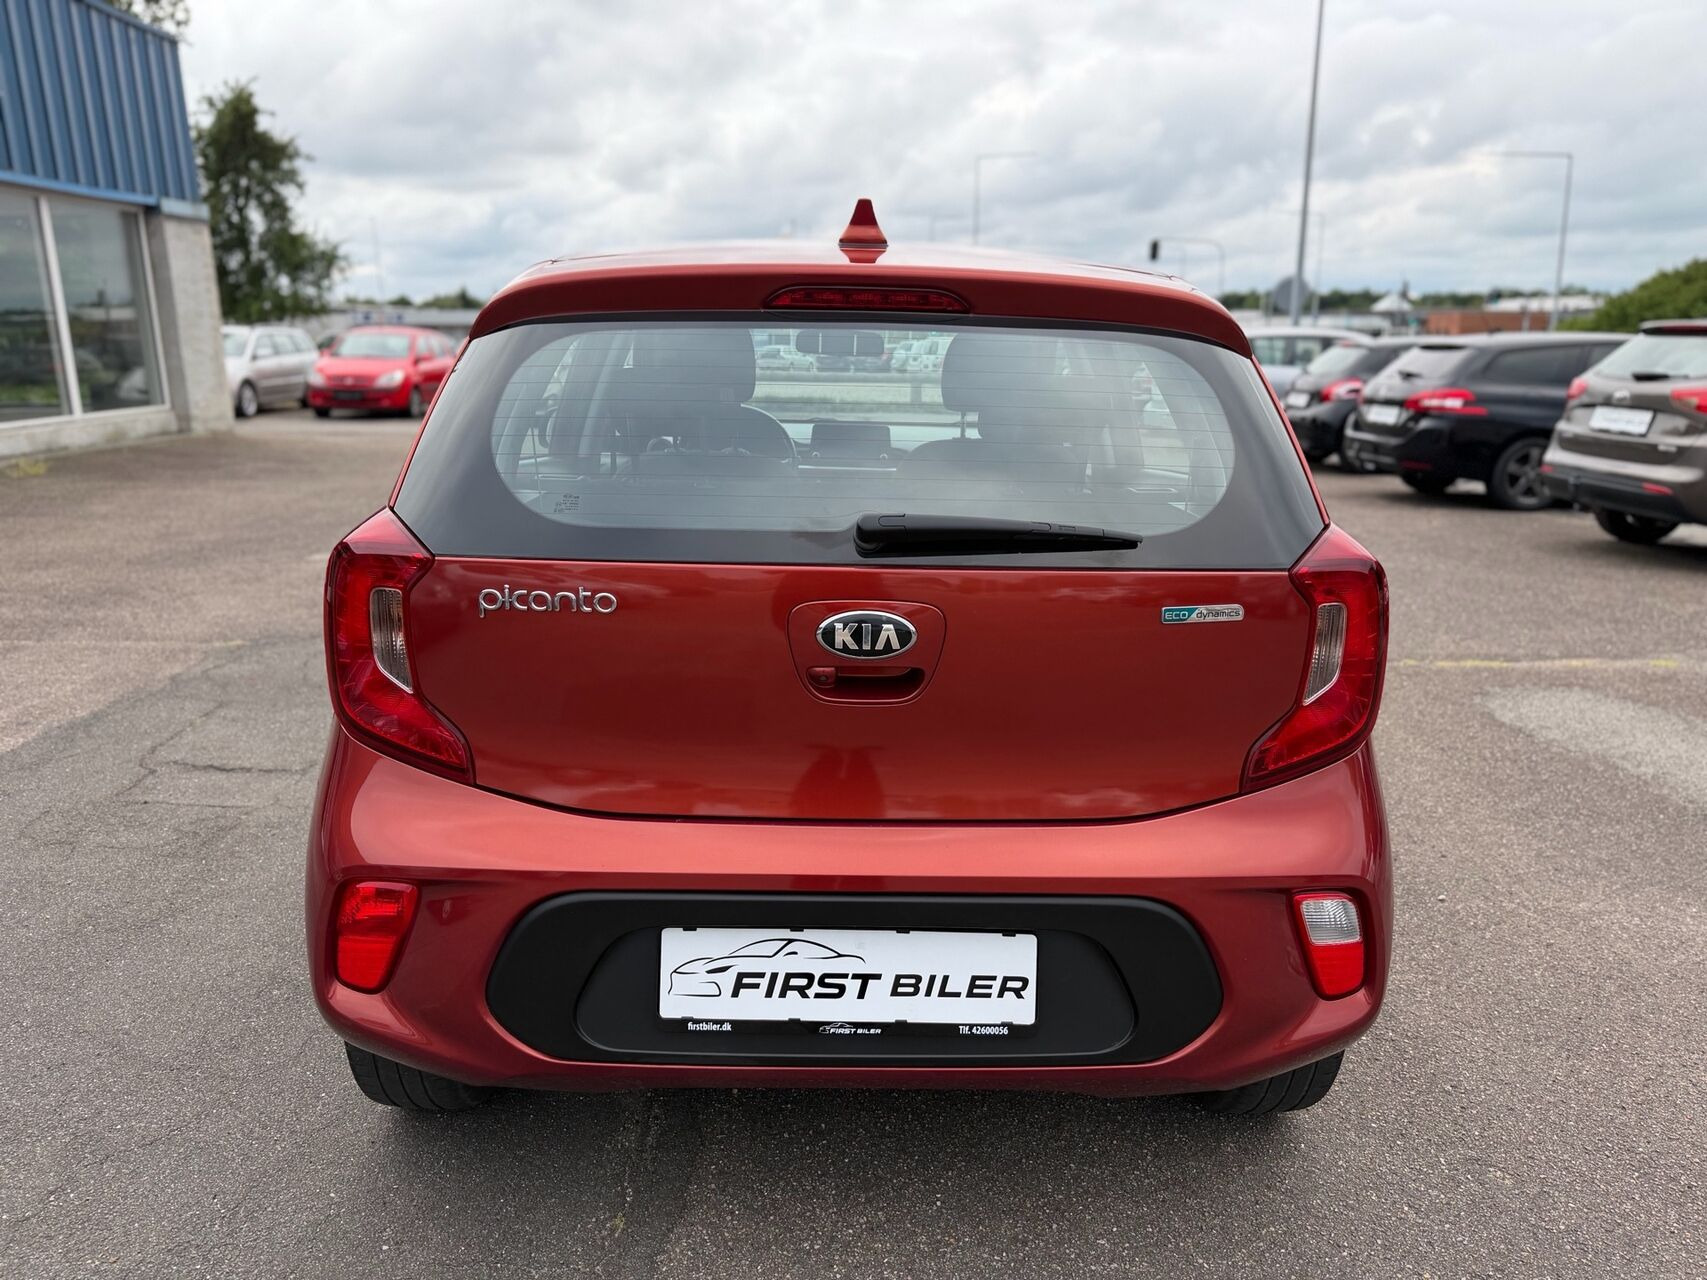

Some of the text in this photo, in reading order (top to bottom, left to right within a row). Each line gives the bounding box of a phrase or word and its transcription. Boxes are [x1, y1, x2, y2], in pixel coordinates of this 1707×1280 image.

[479, 584, 617, 618] picanto
[1165, 609, 1240, 620] ECO dynamics
[833, 622, 901, 650] KIA
[730, 971, 1030, 1000] FIRST BILER
[687, 1021, 732, 1031] firstbiler.dk
[829, 1027, 857, 1035] FIRST
[958, 1025, 1009, 1035] Tlf. 42600056
